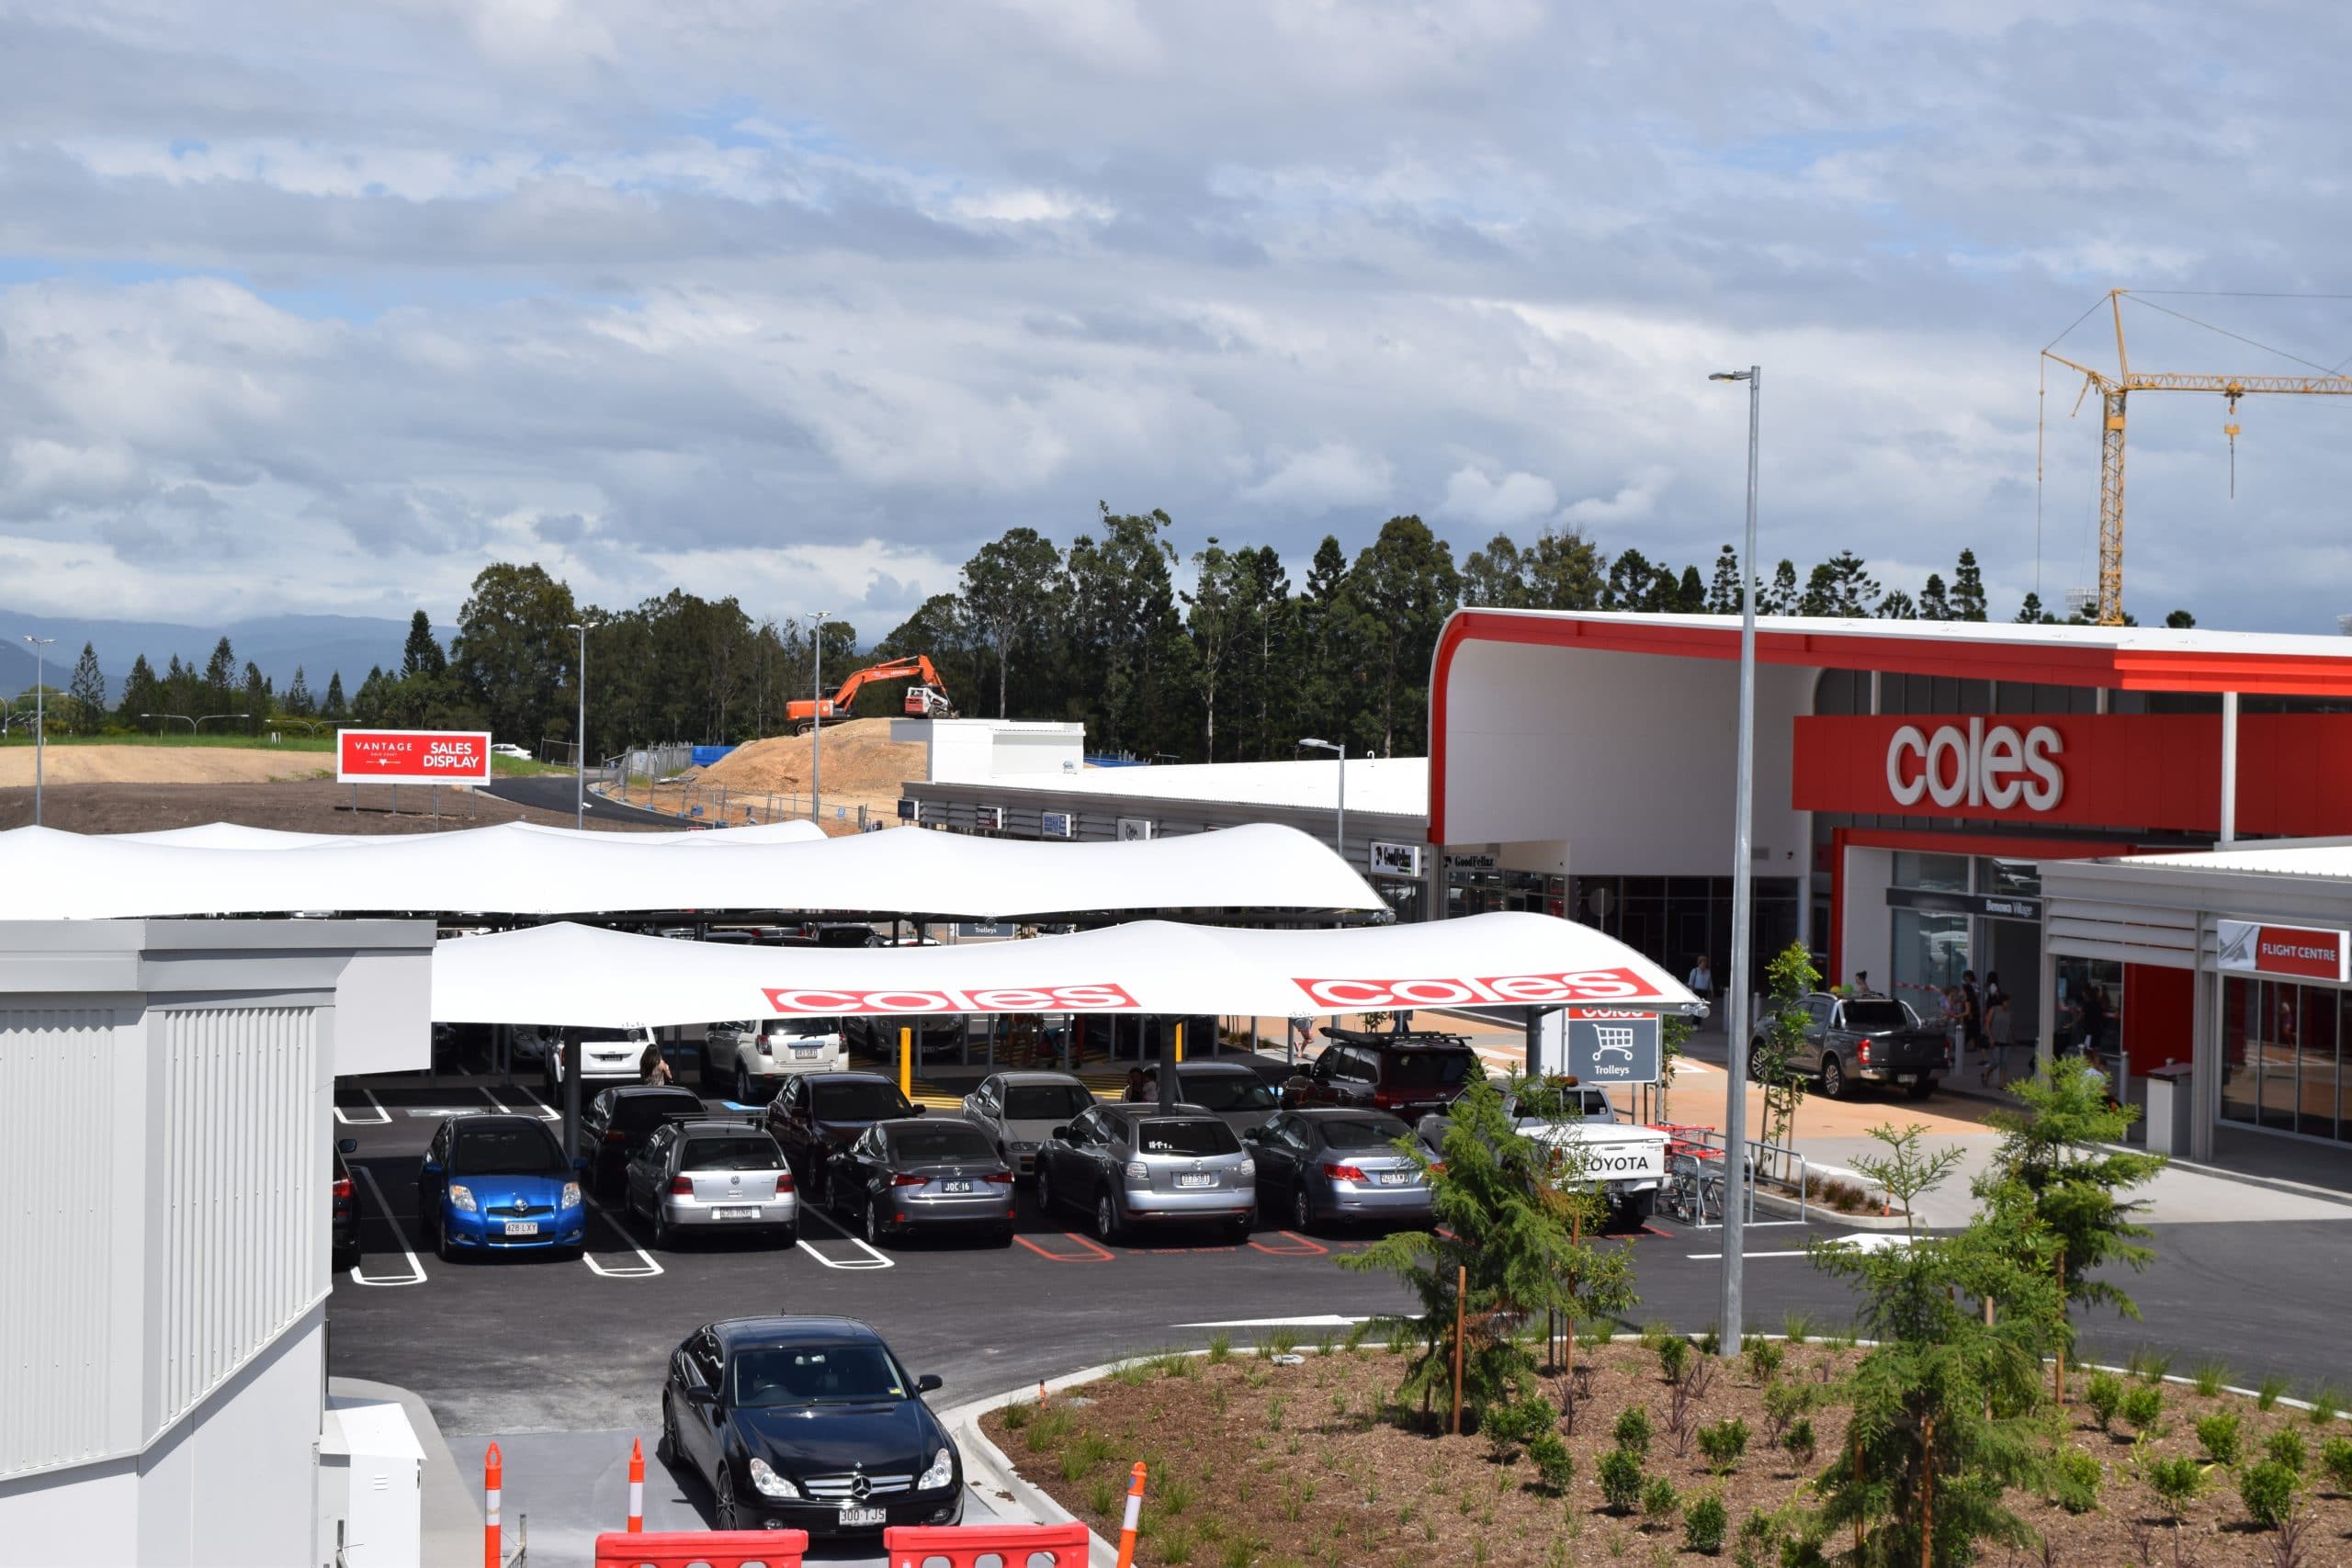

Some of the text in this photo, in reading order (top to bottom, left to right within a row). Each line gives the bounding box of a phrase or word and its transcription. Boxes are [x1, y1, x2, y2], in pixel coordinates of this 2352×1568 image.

[355, 741, 413, 751] VANTAGE
[430, 741, 472, 755] SALES
[423, 755, 480, 768] DISPLAY
[1886, 716, 2064, 811] coles
[2262, 942, 2336, 962] FLIGHT CENTRE
[1310, 971, 1639, 1006] coles
[776, 985, 1127, 1010] coles
[1594, 1065, 1630, 1077] Trolleys
